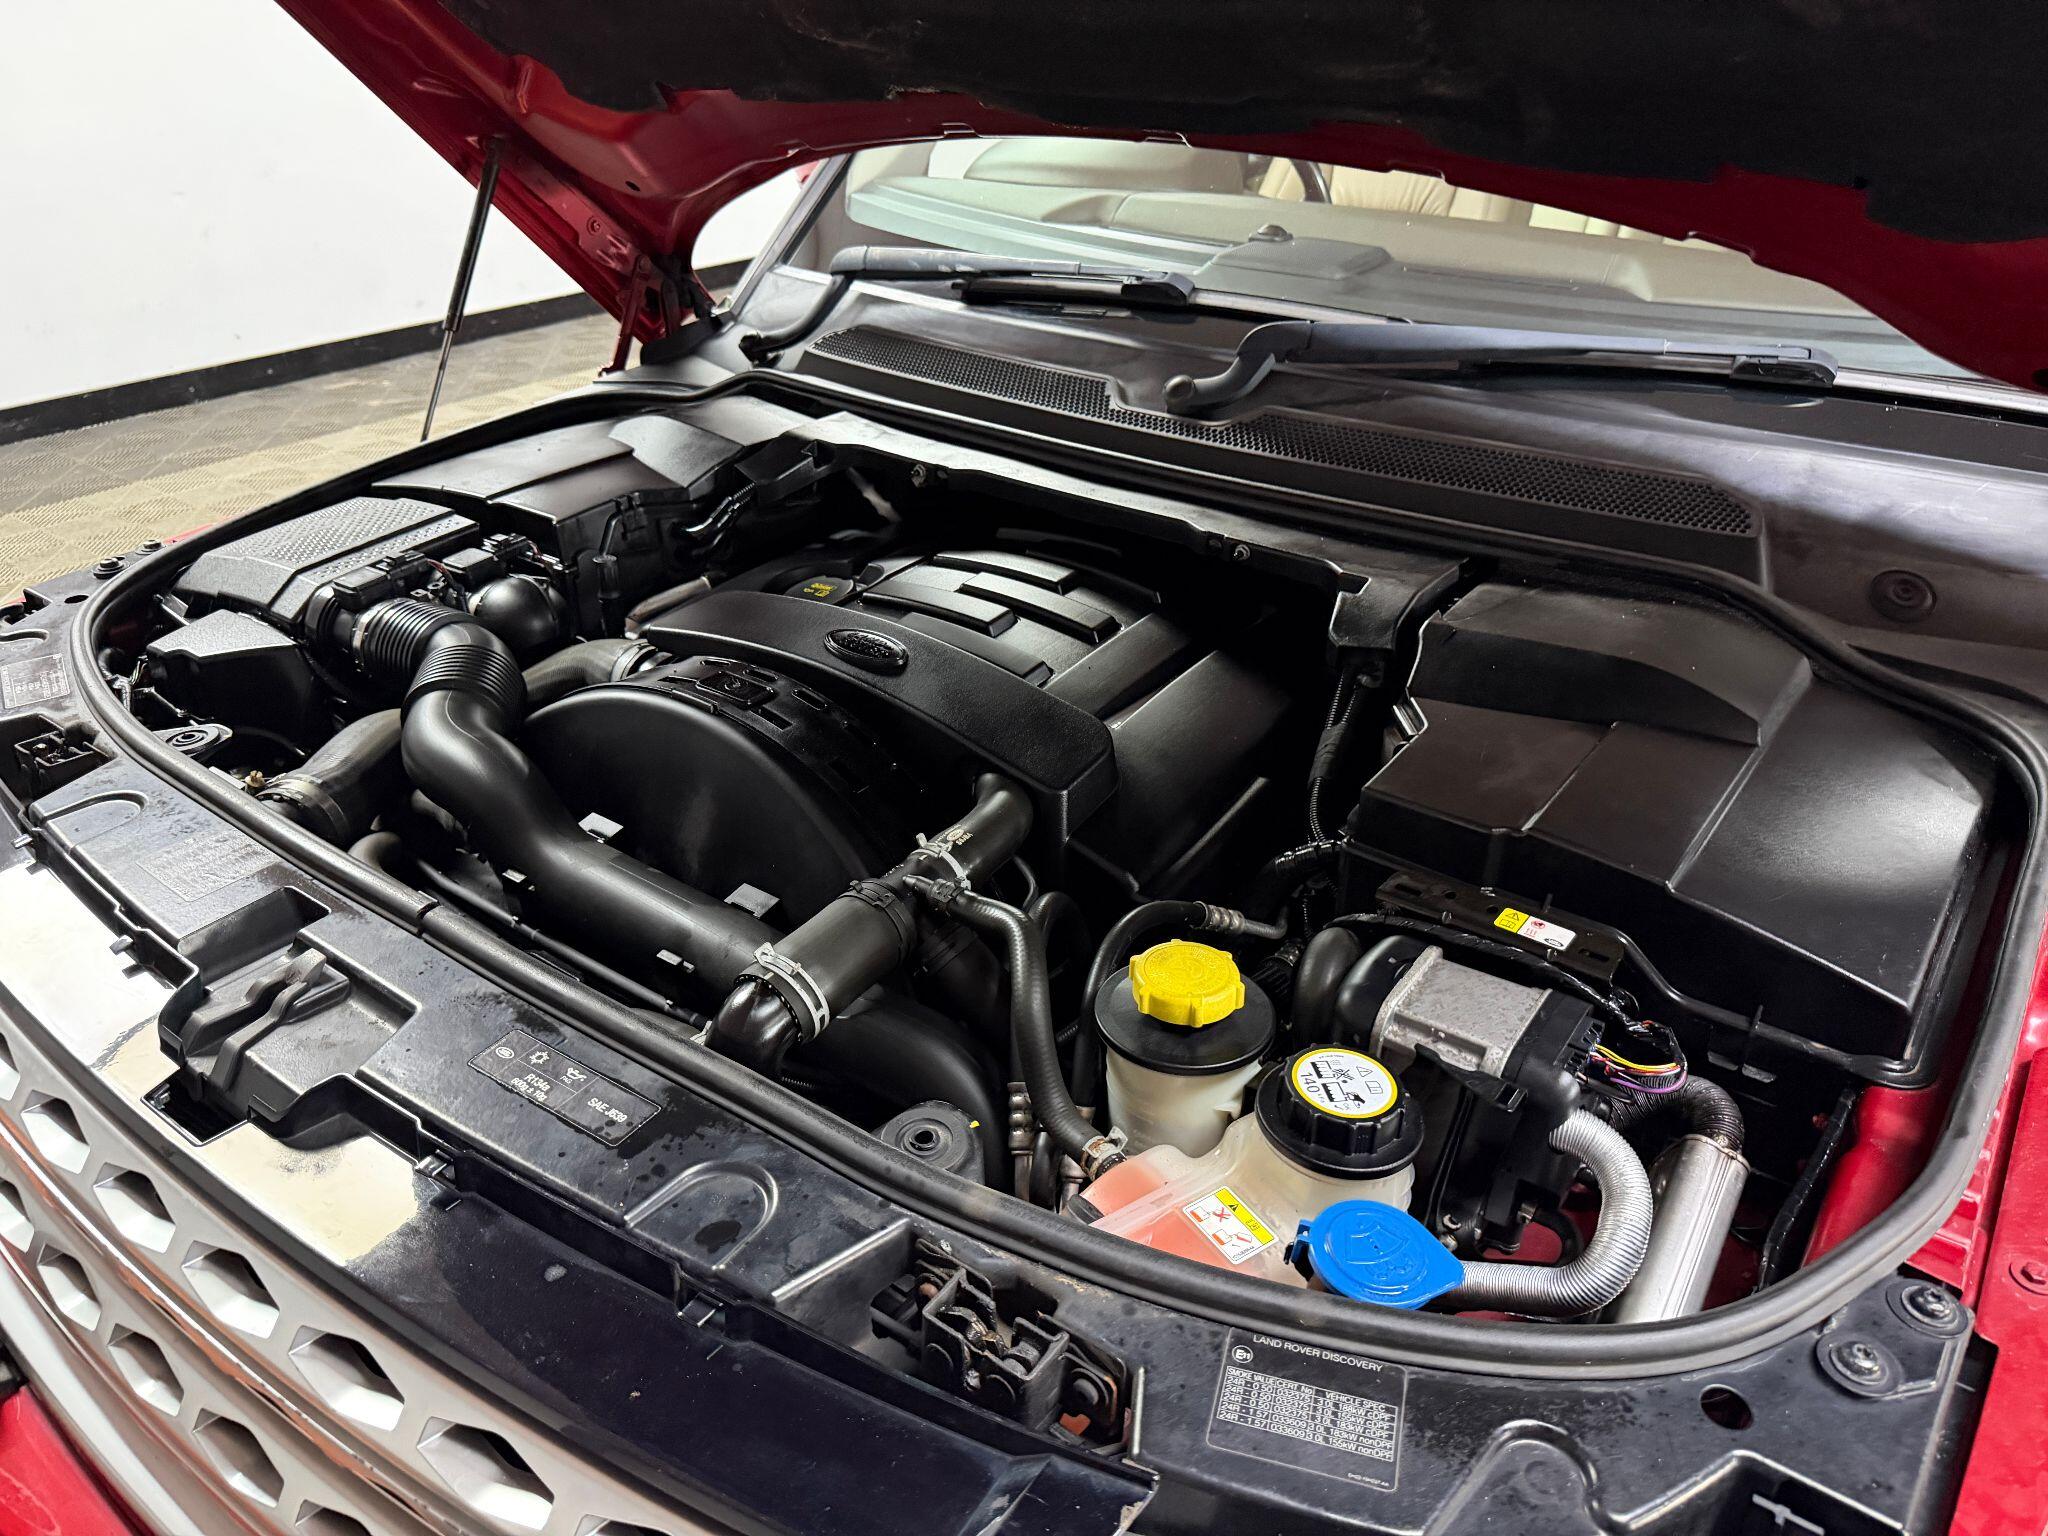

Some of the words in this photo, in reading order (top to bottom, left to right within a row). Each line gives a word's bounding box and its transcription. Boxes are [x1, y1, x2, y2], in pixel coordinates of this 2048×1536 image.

[511, 1077, 529, 1091] 600g
[524, 1073, 550, 1091] R134a
[1300, 1072, 1320, 1093] 140
[588, 1097, 609, 1112] SAE
[605, 1108, 627, 1122] J639
[1253, 1335, 1282, 1348] LAND
[1284, 1342, 1320, 1357] ROVER
[1322, 1351, 1383, 1372] DISCOVERY
[1228, 1368, 1253, 1380] SMOKE
[1253, 1374, 1275, 1385] VALUE
[1277, 1388, 1311, 1402] 032375
[1325, 1392, 1361, 1406] VEHICLE
[1363, 1401, 1386, 1412] SPEC
[1275, 1397, 1310, 1410] 032375
[1273, 1405, 1308, 1419] 032375
[1272, 1414, 1307, 1429] 033609
[1270, 1423, 1305, 1438] 033609
[1359, 1436, 1392, 1450] nonDPF
[1358, 1445, 1392, 1459] nonDPF
